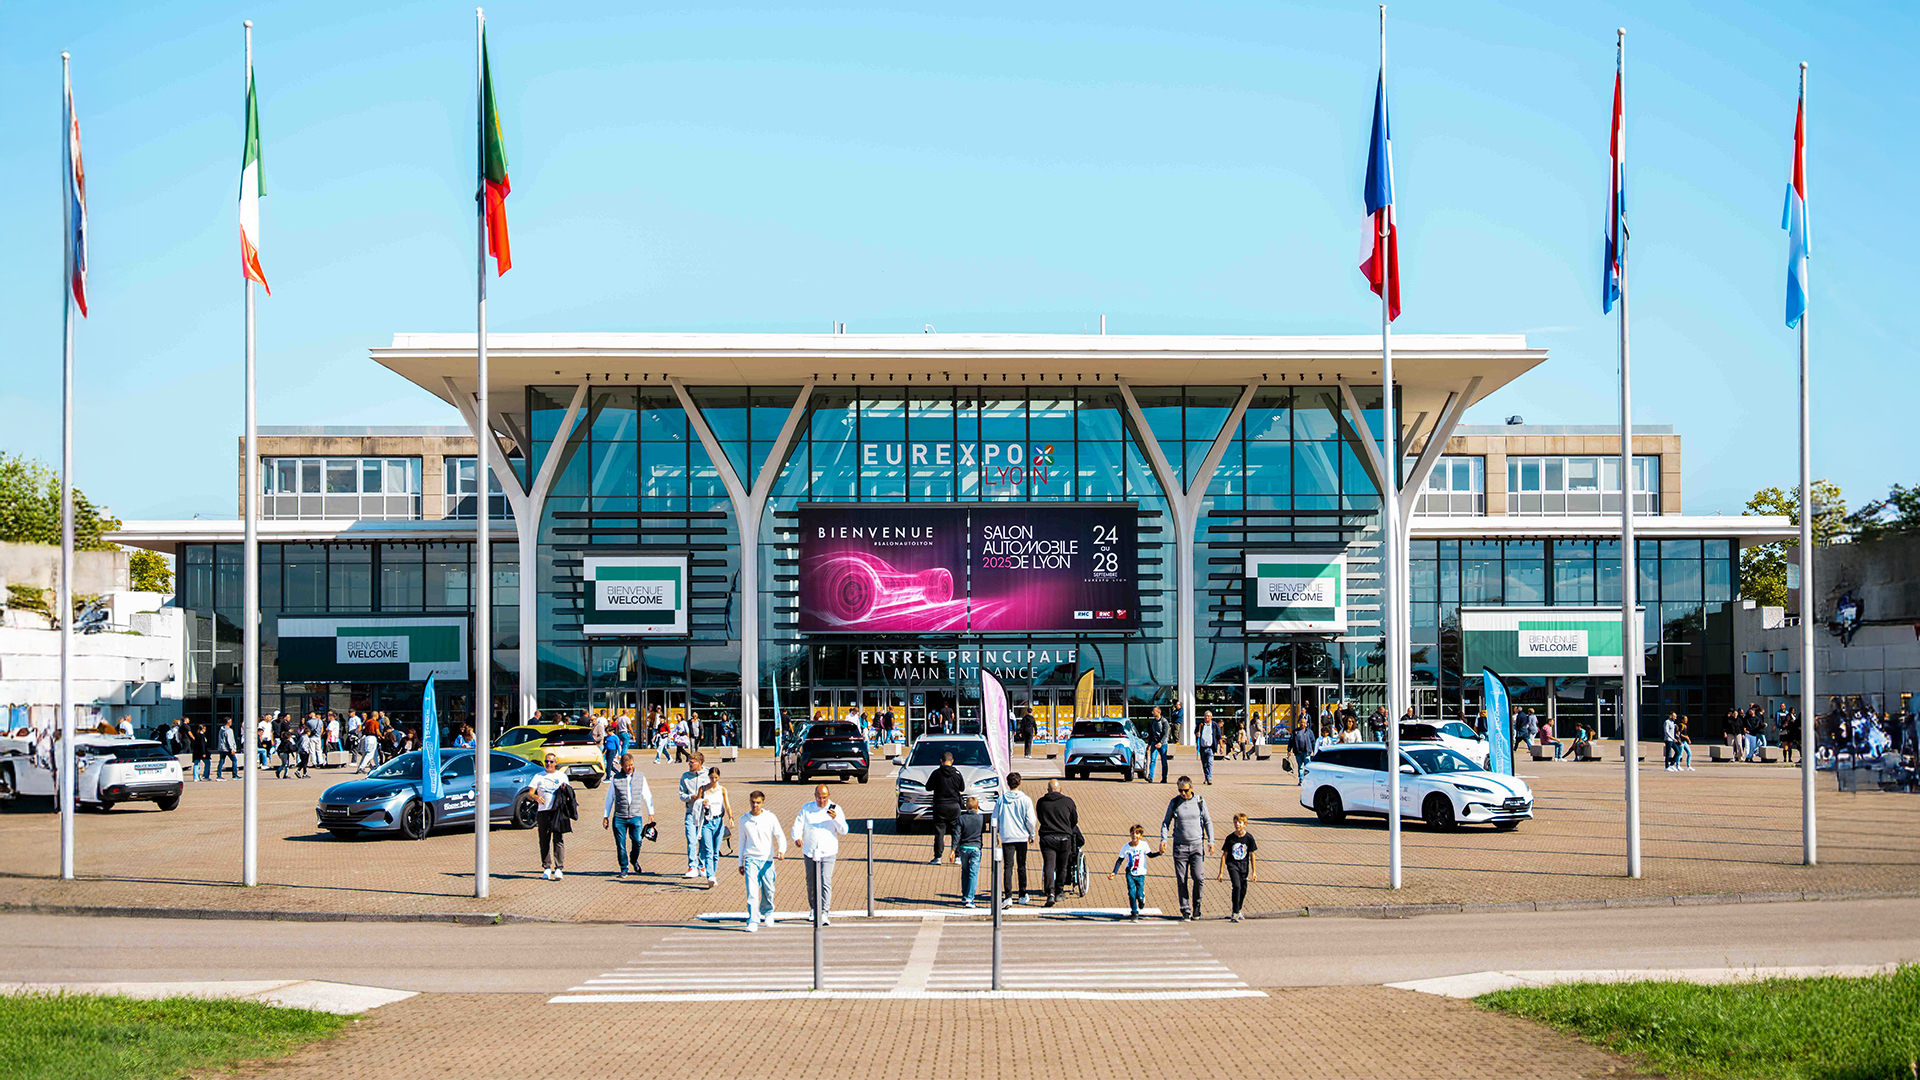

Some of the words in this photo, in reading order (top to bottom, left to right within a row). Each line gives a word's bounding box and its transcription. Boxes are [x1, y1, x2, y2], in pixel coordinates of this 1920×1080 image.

[863, 444, 1023, 465] EUREXPO
[985, 466, 1047, 485] LYON
[818, 527, 933, 538] BIENVENUE
[983, 525, 1033, 540] SALON
[1092, 525, 1118, 544] 24
[982, 541, 1078, 555] AUTOMOBILE
[982, 557, 1011, 568] 2025
[1010, 555, 1029, 569] DE
[1033, 555, 1071, 569] LYON
[1092, 553, 1118, 572] 28
[606, 586, 663, 595] BIENVENUE
[1268, 583, 1323, 592] BIENVENUE
[607, 596, 663, 605] WELCOME
[1269, 593, 1323, 602] WELCOME
[1528, 635, 1578, 644] BIENVENUE
[347, 641, 398, 650] BIENVENUE
[1529, 644, 1578, 652] WELCOME
[347, 650, 398, 659] WELCOME
[860, 651, 939, 664] ENTREE
[948, 650, 1077, 664] PRINCIPALE
[893, 667, 940, 680] MAIN
[948, 666, 1038, 680] ENTANCE
